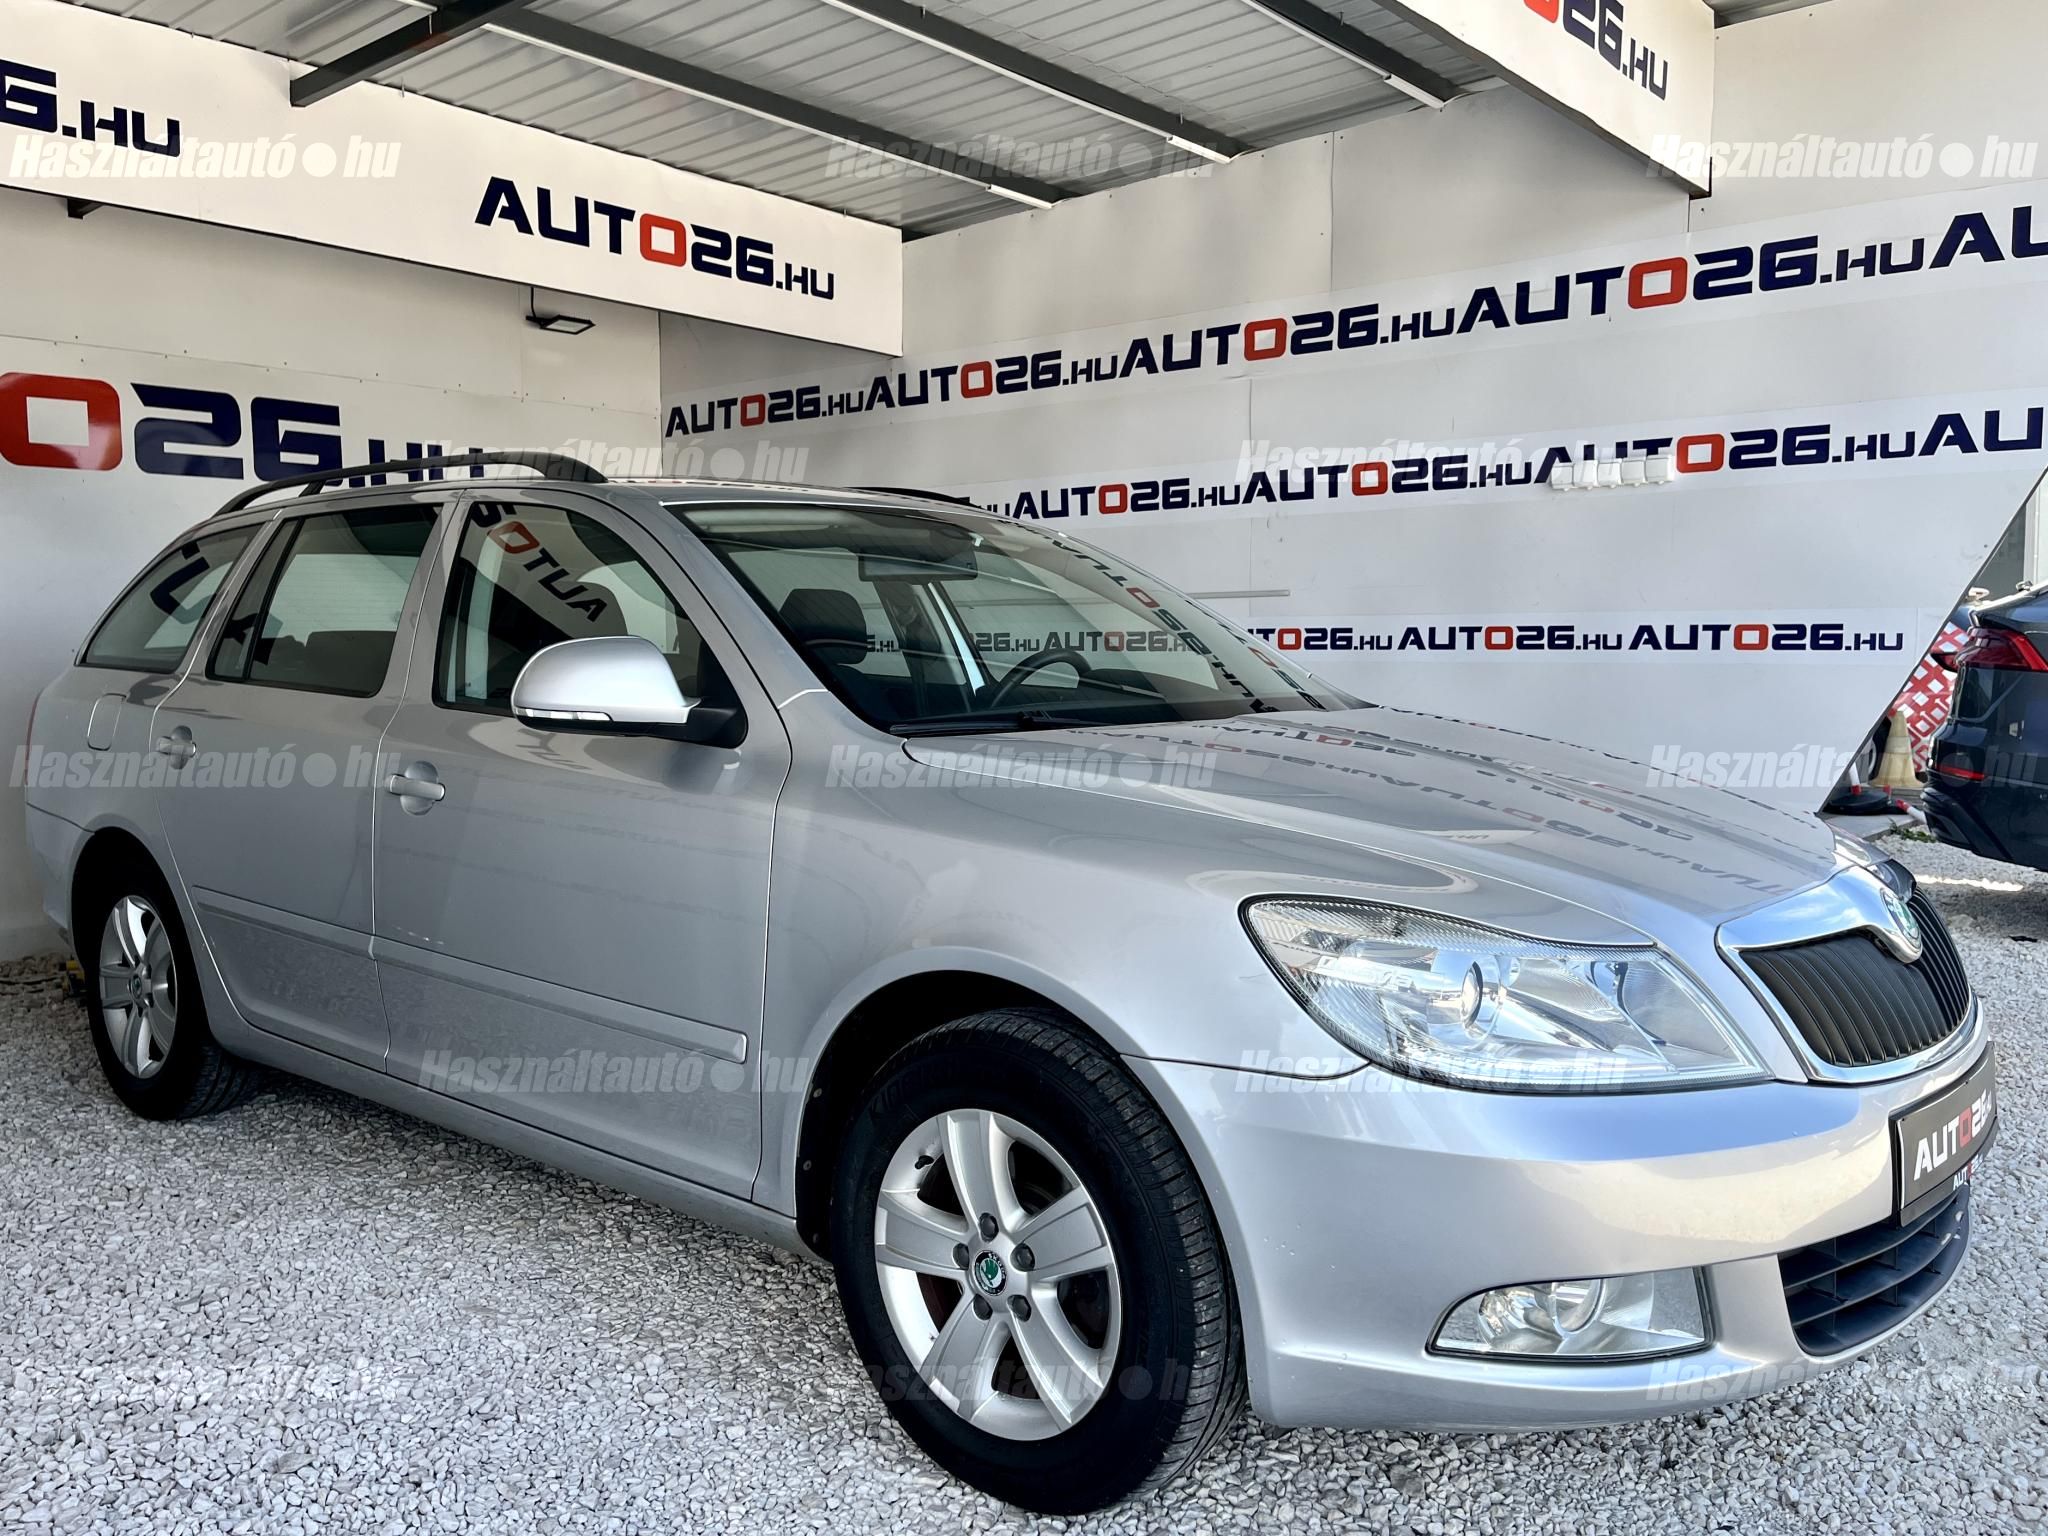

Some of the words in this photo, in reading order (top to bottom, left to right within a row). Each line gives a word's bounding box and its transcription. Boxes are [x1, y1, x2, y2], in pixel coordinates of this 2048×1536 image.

[475, 176, 834, 300] AUTO26.HU
[665, 386, 864, 437] AUTO26.HU
[865, 350, 1118, 411] AUTO26.HU
[1119, 303, 1455, 378] AUTO26.HU
[1456, 236, 1924, 333] AUTO26.HU
[1012, 478, 1241, 519] AUTO26.HU
[1242, 455, 1532, 506] AUTO26.HU
[1397, 625, 1622, 651] AUTO26.HU
[1628, 624, 1904, 652] AUTO26.HU
